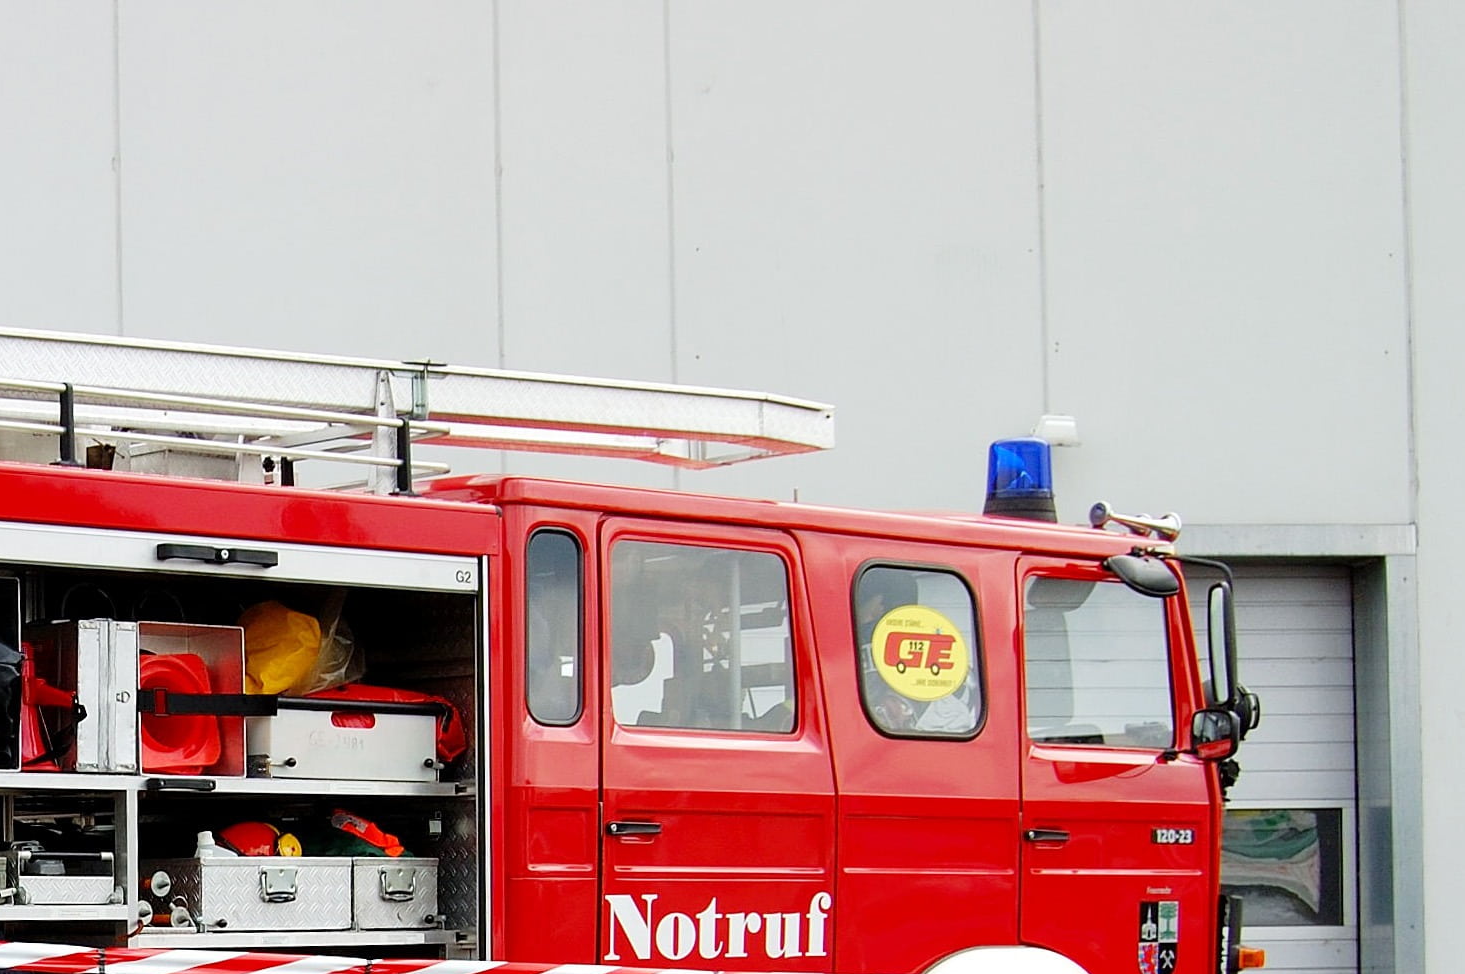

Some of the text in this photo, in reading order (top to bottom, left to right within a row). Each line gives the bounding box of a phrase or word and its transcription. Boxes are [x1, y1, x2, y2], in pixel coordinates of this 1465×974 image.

[455, 570, 472, 584] G2
[909, 641, 924, 651] 112
[604, 892, 832, 961] Notruf
